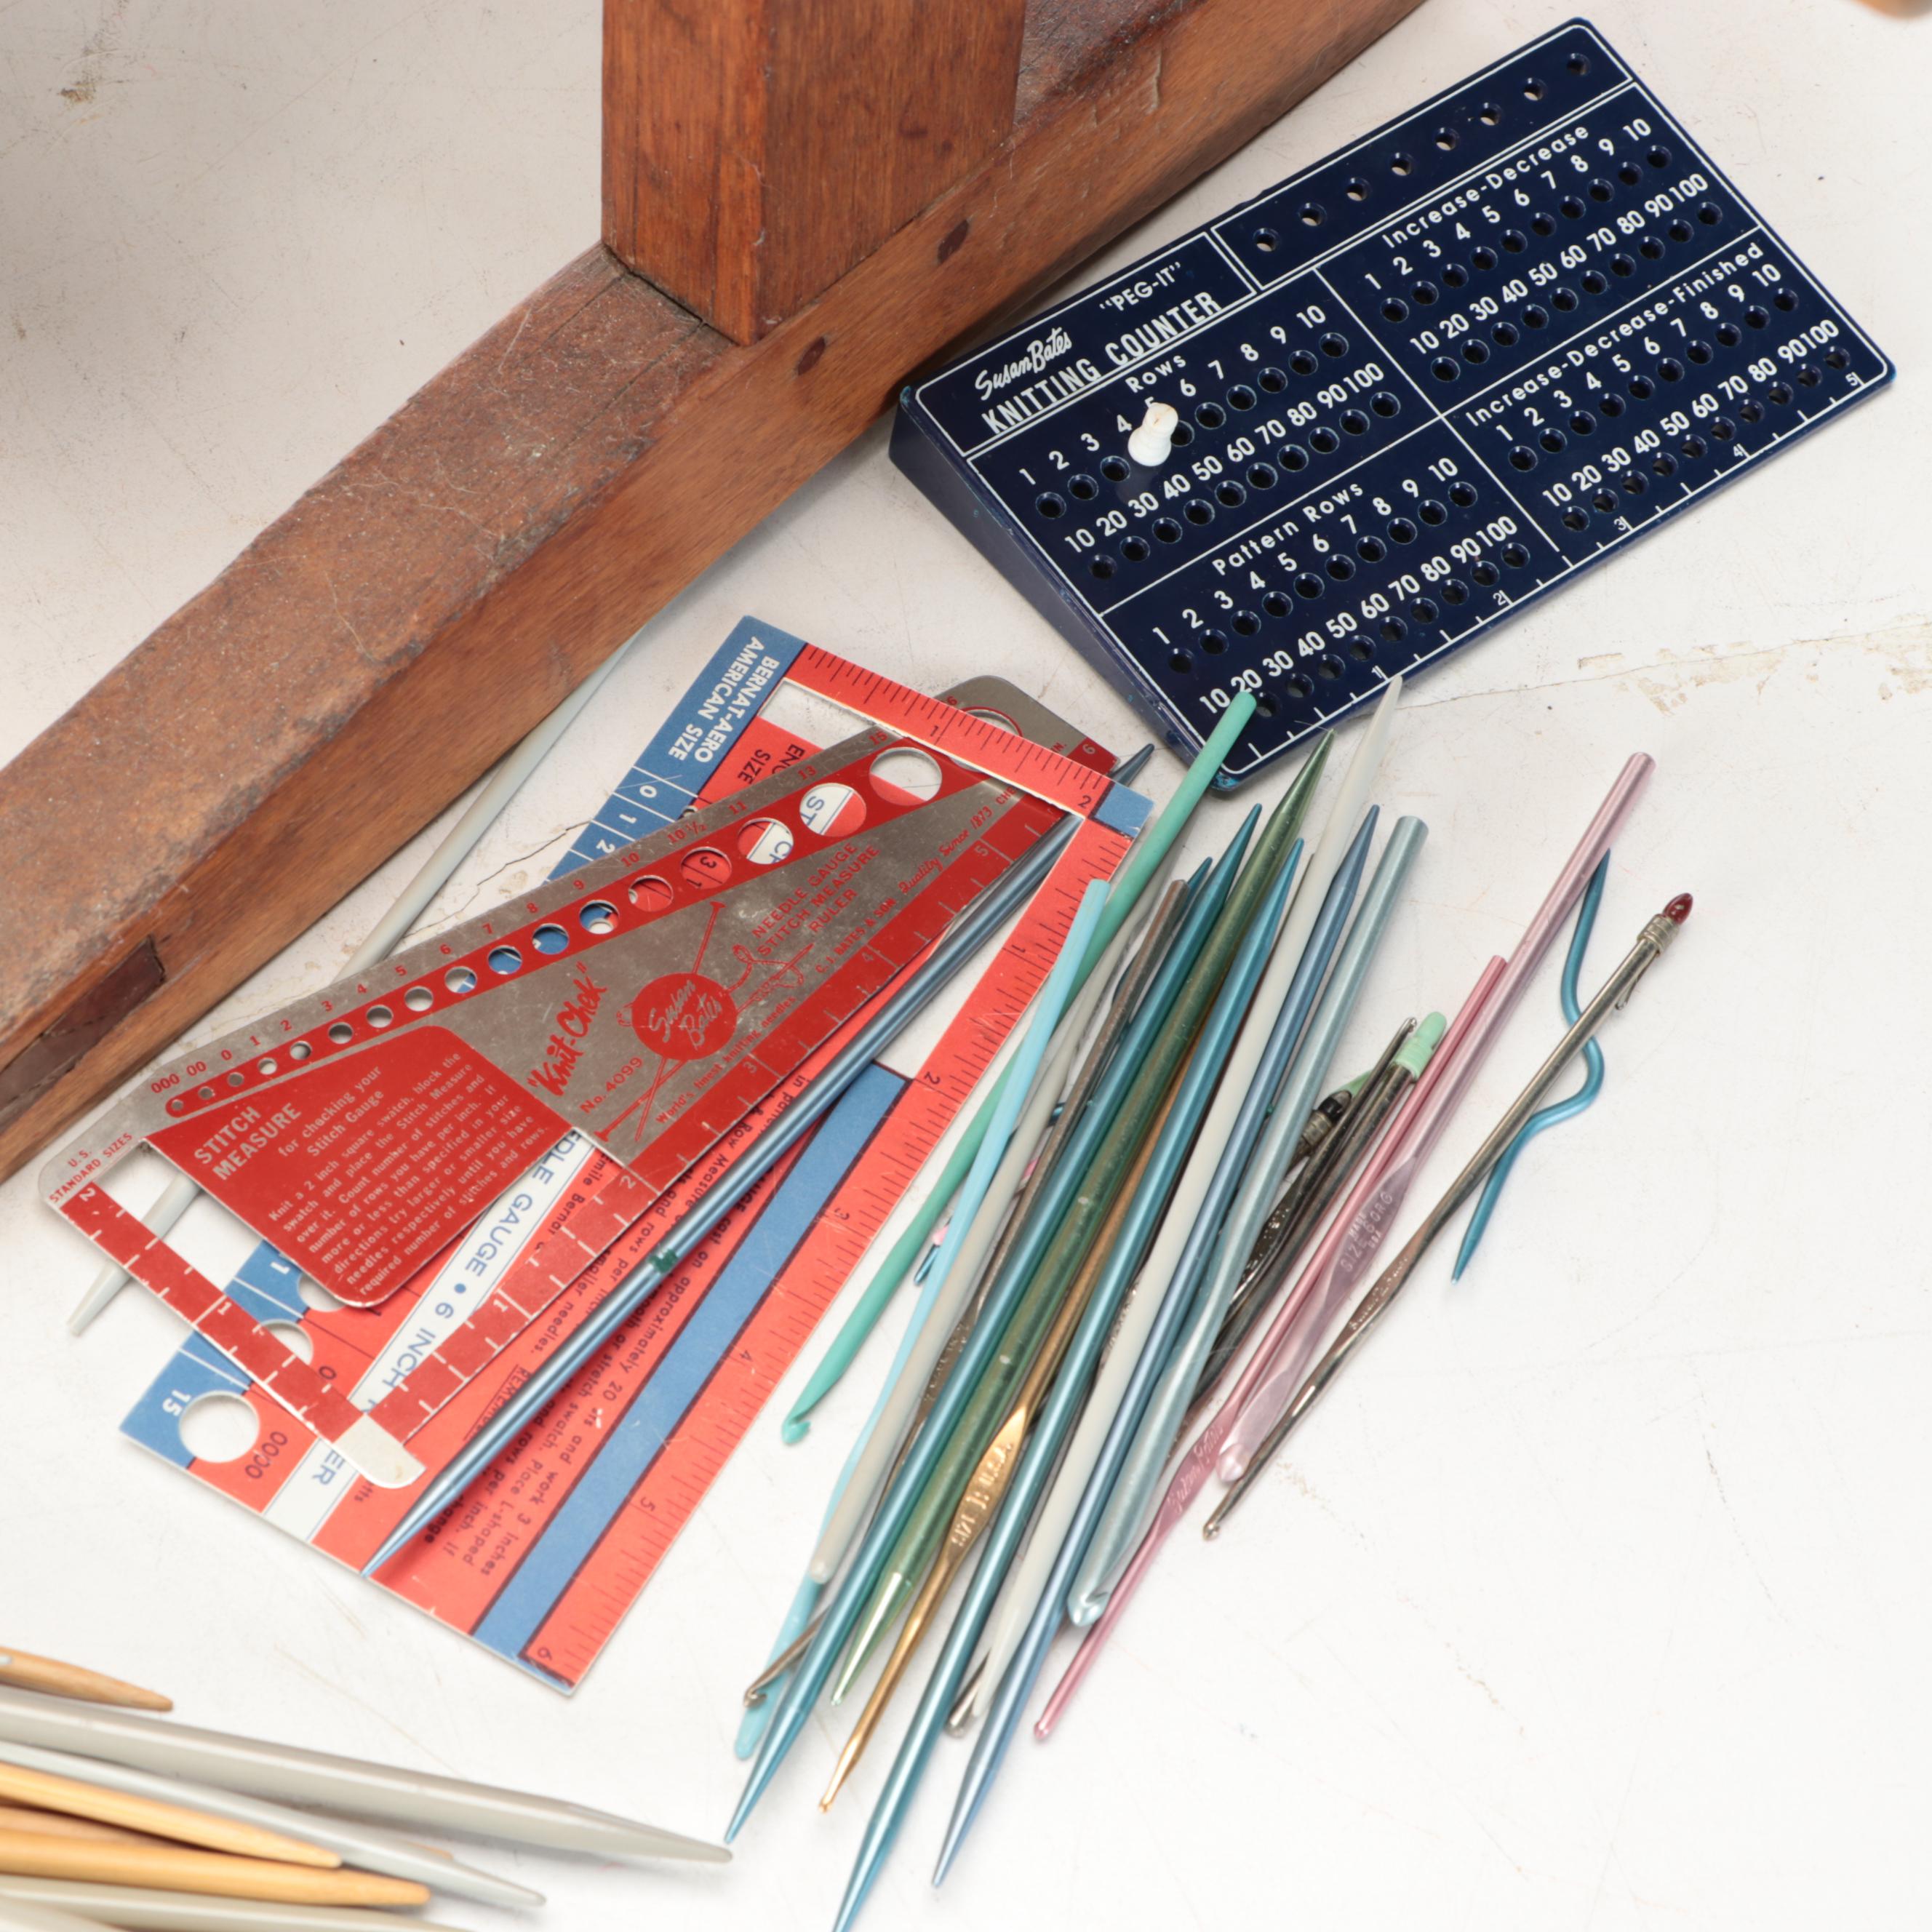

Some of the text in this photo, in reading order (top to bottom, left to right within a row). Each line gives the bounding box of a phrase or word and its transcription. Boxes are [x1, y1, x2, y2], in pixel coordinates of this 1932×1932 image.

[1365, 119, 1650, 289] 1 2 3 4 5 6 7 8 9 10
[1383, 127, 1588, 247] Increase-Decrease
[975, 327, 1072, 400] Susan Bates
[981, 292, 1223, 434] KNITTING COUNTER
[1466, 242, 1763, 426] Increase-Decrease-Finished
[1020, 306, 1325, 484] 1 2 3 4 6 7 8 9 10
[1125, 356, 1186, 392] Rows
[1065, 363, 1384, 552] 10 20 30 40 50 60 70 80 90 100
[1493, 375, 1859, 607] 2 3 4 5
[1153, 458, 1458, 644] 1 2 3 4 5 6 7 8 9 10
[1213, 484, 1362, 575] Pattern Rows
[668, 636, 759, 760] AMERICAN SIZE
[693, 657, 780, 762] BERNAT-AERO
[737, 749, 770, 787] SIZE
[1082, 743, 1095, 754] 6
[619, 814, 636, 823] 1
[1077, 794, 1092, 809] 2
[596, 839, 615, 853] 2
[898, 806, 992, 893] Quality Since 1873
[974, 845, 989, 856] 5
[151, 1074, 180, 1093] 000
[186, 1061, 206, 1076] 00
[220, 1050, 232, 1061] 0
[250, 1035, 260, 1045] 1
[280, 1020, 292, 1031] 2
[322, 1000, 332, 1012] 3
[357, 983, 367, 994] 4
[395, 965, 407, 975] 5
[439, 944, 451, 954] 6
[482, 923, 492, 934] 7
[527, 903, 538, 913] 8
[573, 879, 584, 890] 9
[621, 853, 639, 866] 10
[729, 801, 746, 814] 11
[798, 765, 816, 780] 13
[869, 730, 887, 746] 15
[751, 842, 858, 942] NEEDLE GAUGE
[757, 847, 879, 956] STITCH MEASURE
[809, 888, 858, 932] RULER
[834, 898, 896, 954] BATES SON
[861, 951, 874, 961] 4
[647, 979, 724, 1051] Susan Bates
[580, 1057, 642, 1113] No. 4099
[656, 997, 797, 1123] World's finest knitting needles
[744, 1061, 756, 1073] 3
[923, 1071, 941, 1087] 2
[194, 1106, 260, 1164] STITCH
[212, 1103, 300, 1180] MEASURE
[268, 1200, 292, 1221] Knit
[295, 1191, 303, 1199] a
[304, 1181, 315, 1190] 2
[315, 1160, 339, 1181] inch
[341, 1130, 374, 1157] square
[412, 1071, 442, 1094] block
[442, 1053, 460, 1068] the
[278, 1139, 298, 1156] for
[354, 1066, 380, 1093] your
[307, 1090, 383, 1156] Stitch Gauge
[49, 1133, 132, 1202] STANDARD SIZES
[422, 1129, 469, 1173] specified
[620, 1175, 636, 1189] 2
[79, 1187, 95, 1201] 2
[391, 1186, 455, 1244] respectively
[832, 1207, 851, 1222] 3
[334, 1226, 388, 1274] directions
[359, 1220, 440, 1295] required number
[466, 1193, 533, 1277] GAUGE
[434, 1302, 453, 1318] 6
[493, 1298, 508, 1312] 1
[602, 1276, 690, 1401] approximately 20
[739, 1349, 752, 1365] 4
[162, 1386, 192, 1417] 15
[244, 1431, 287, 1479] 0000
[461, 1402, 579, 1566] swatch. Place L-shaped
[480, 1472, 558, 1576] work 3 inches
[640, 1496, 657, 1512] 5
[537, 1645, 554, 1662] 6
